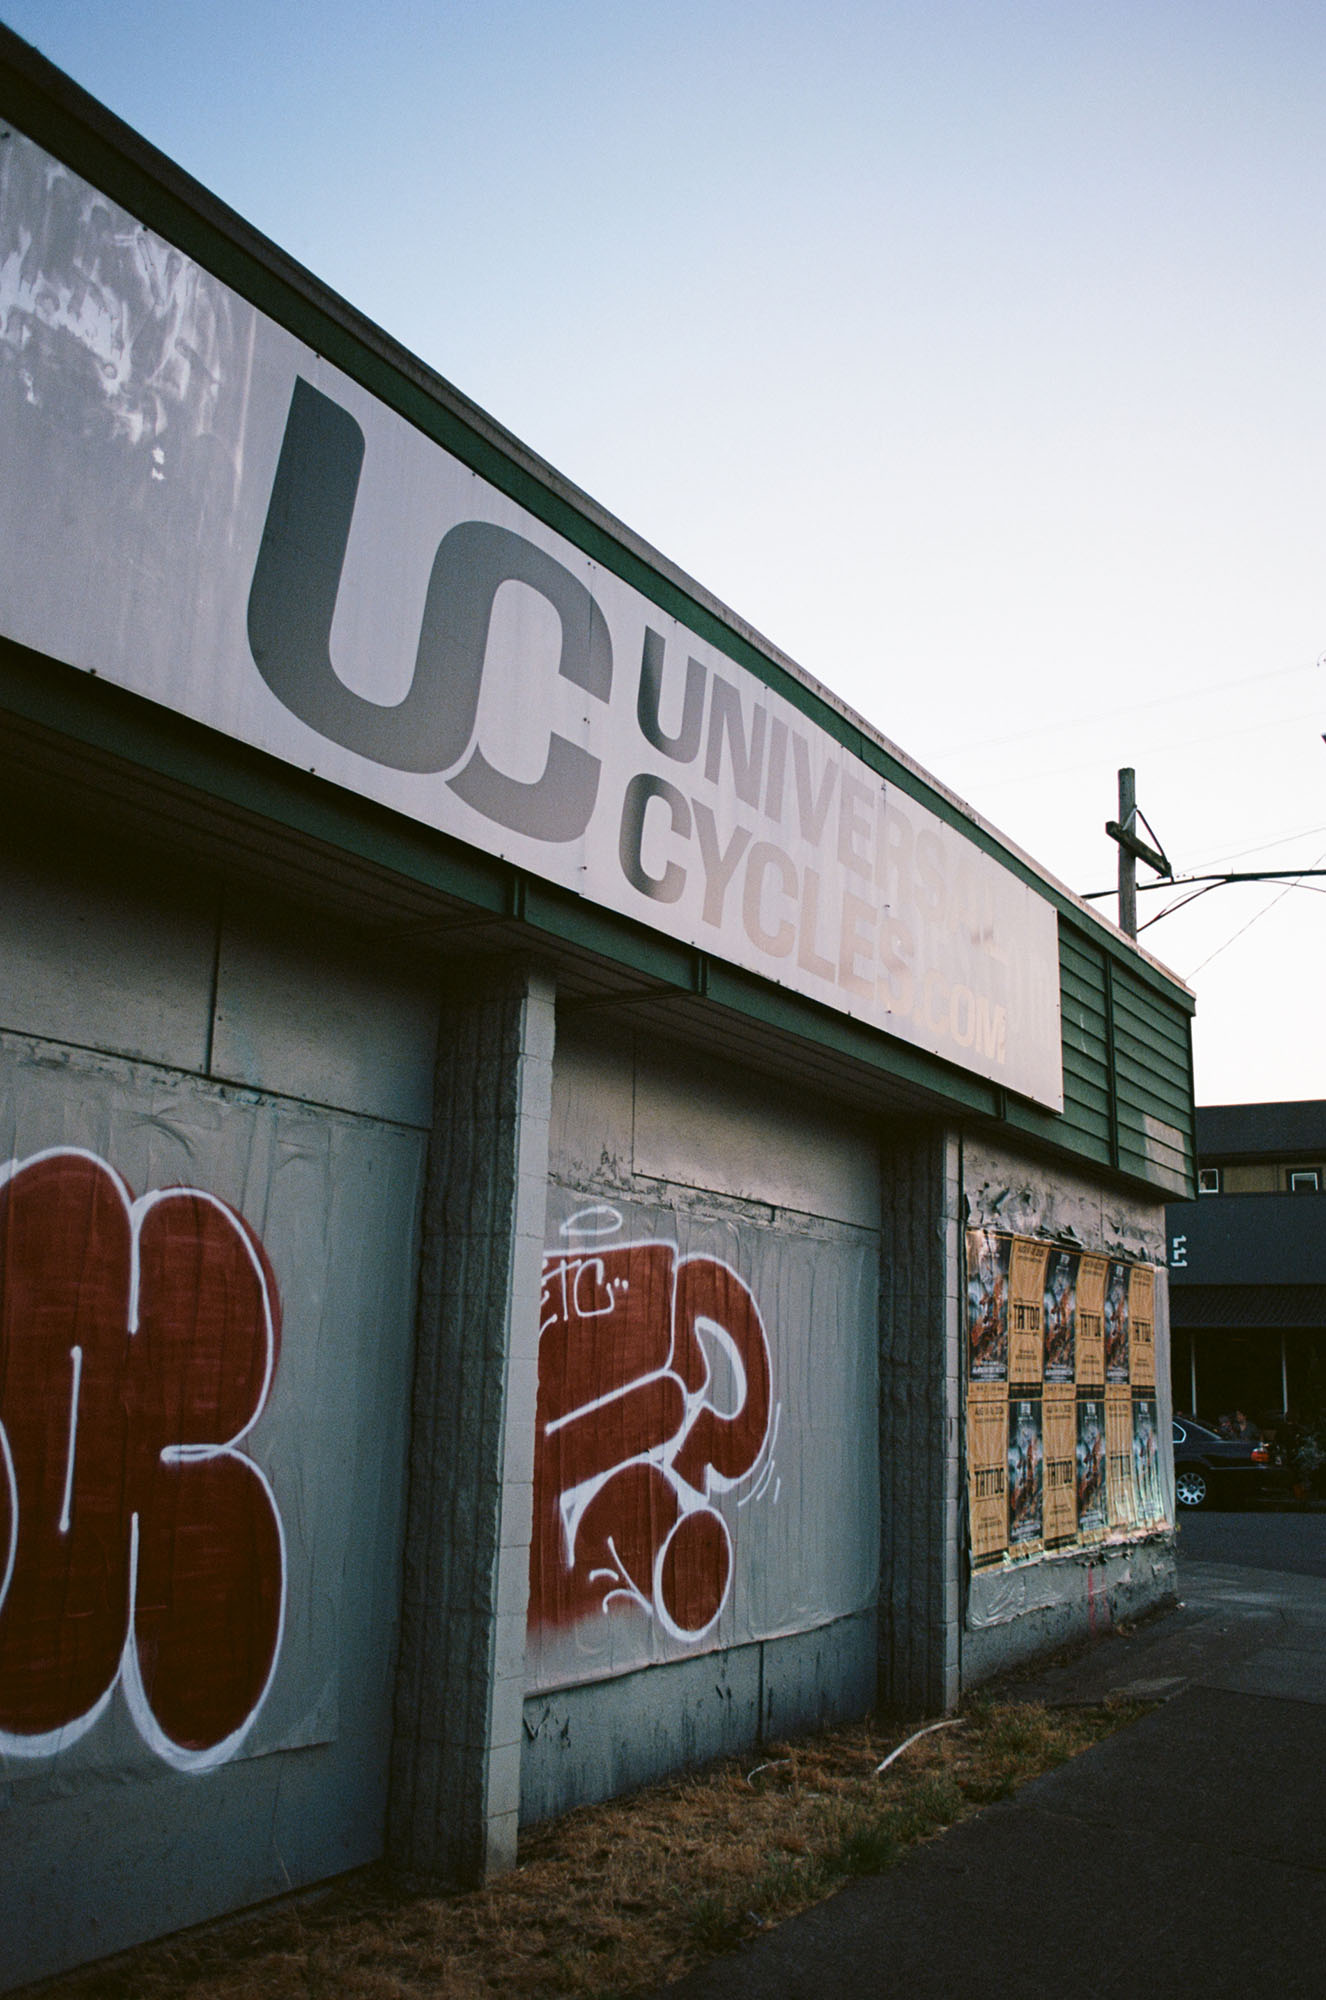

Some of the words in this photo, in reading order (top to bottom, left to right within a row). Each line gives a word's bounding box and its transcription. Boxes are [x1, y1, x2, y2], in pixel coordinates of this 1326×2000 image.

[619, 772, 1006, 1065] CYCLES.COM
[637, 625, 1009, 965] UNIVERSAL
[974, 1467, 1005, 1498] TATTOO
